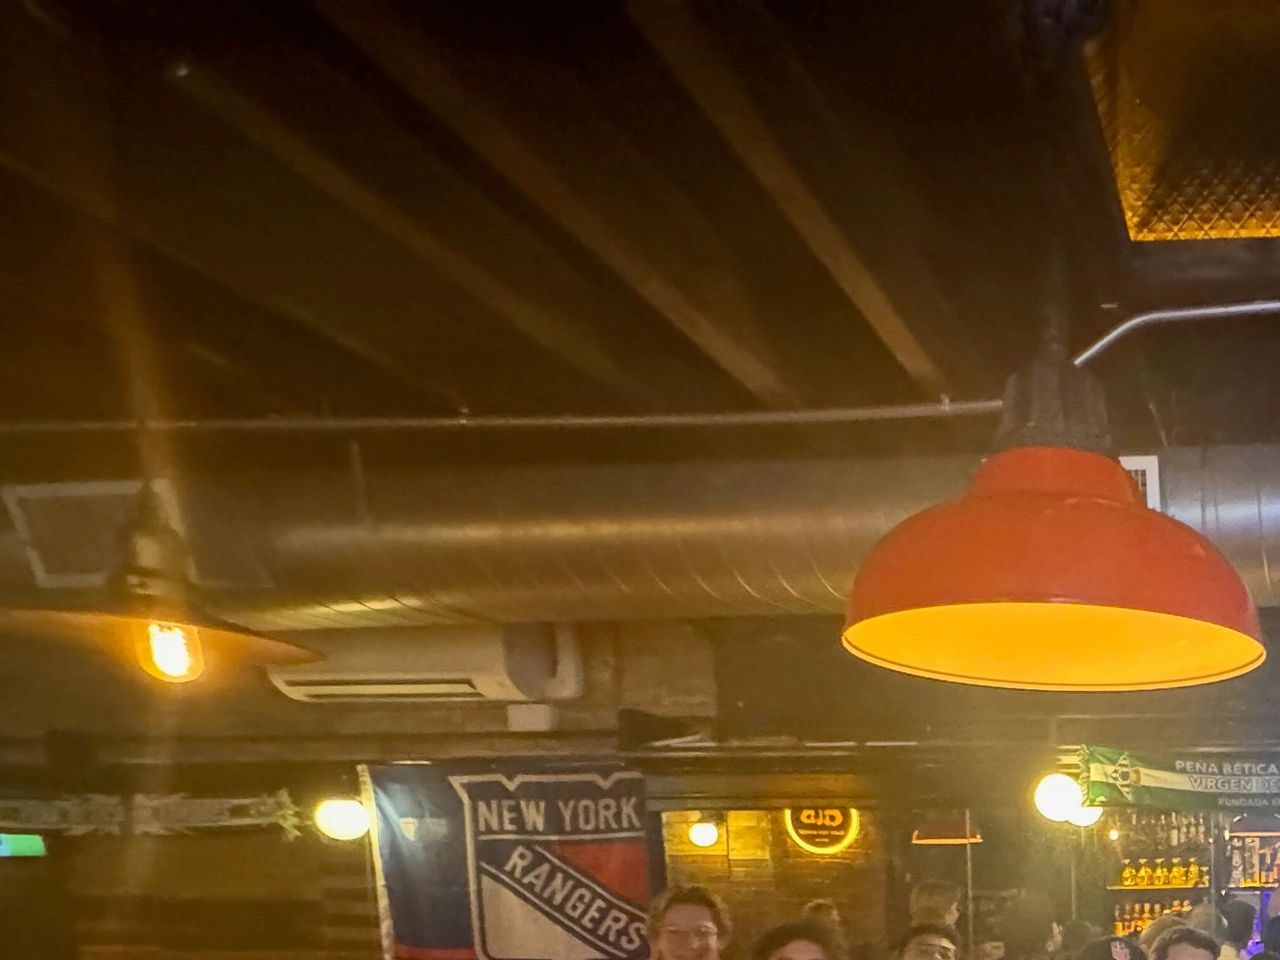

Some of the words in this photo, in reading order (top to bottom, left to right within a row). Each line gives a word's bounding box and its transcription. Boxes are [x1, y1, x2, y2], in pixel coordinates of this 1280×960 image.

[1188, 776, 1251, 792] VIRGEN
[477, 799, 545, 832] NEW
[558, 797, 642, 831] YORK
[504, 845, 648, 951] RANGERS
